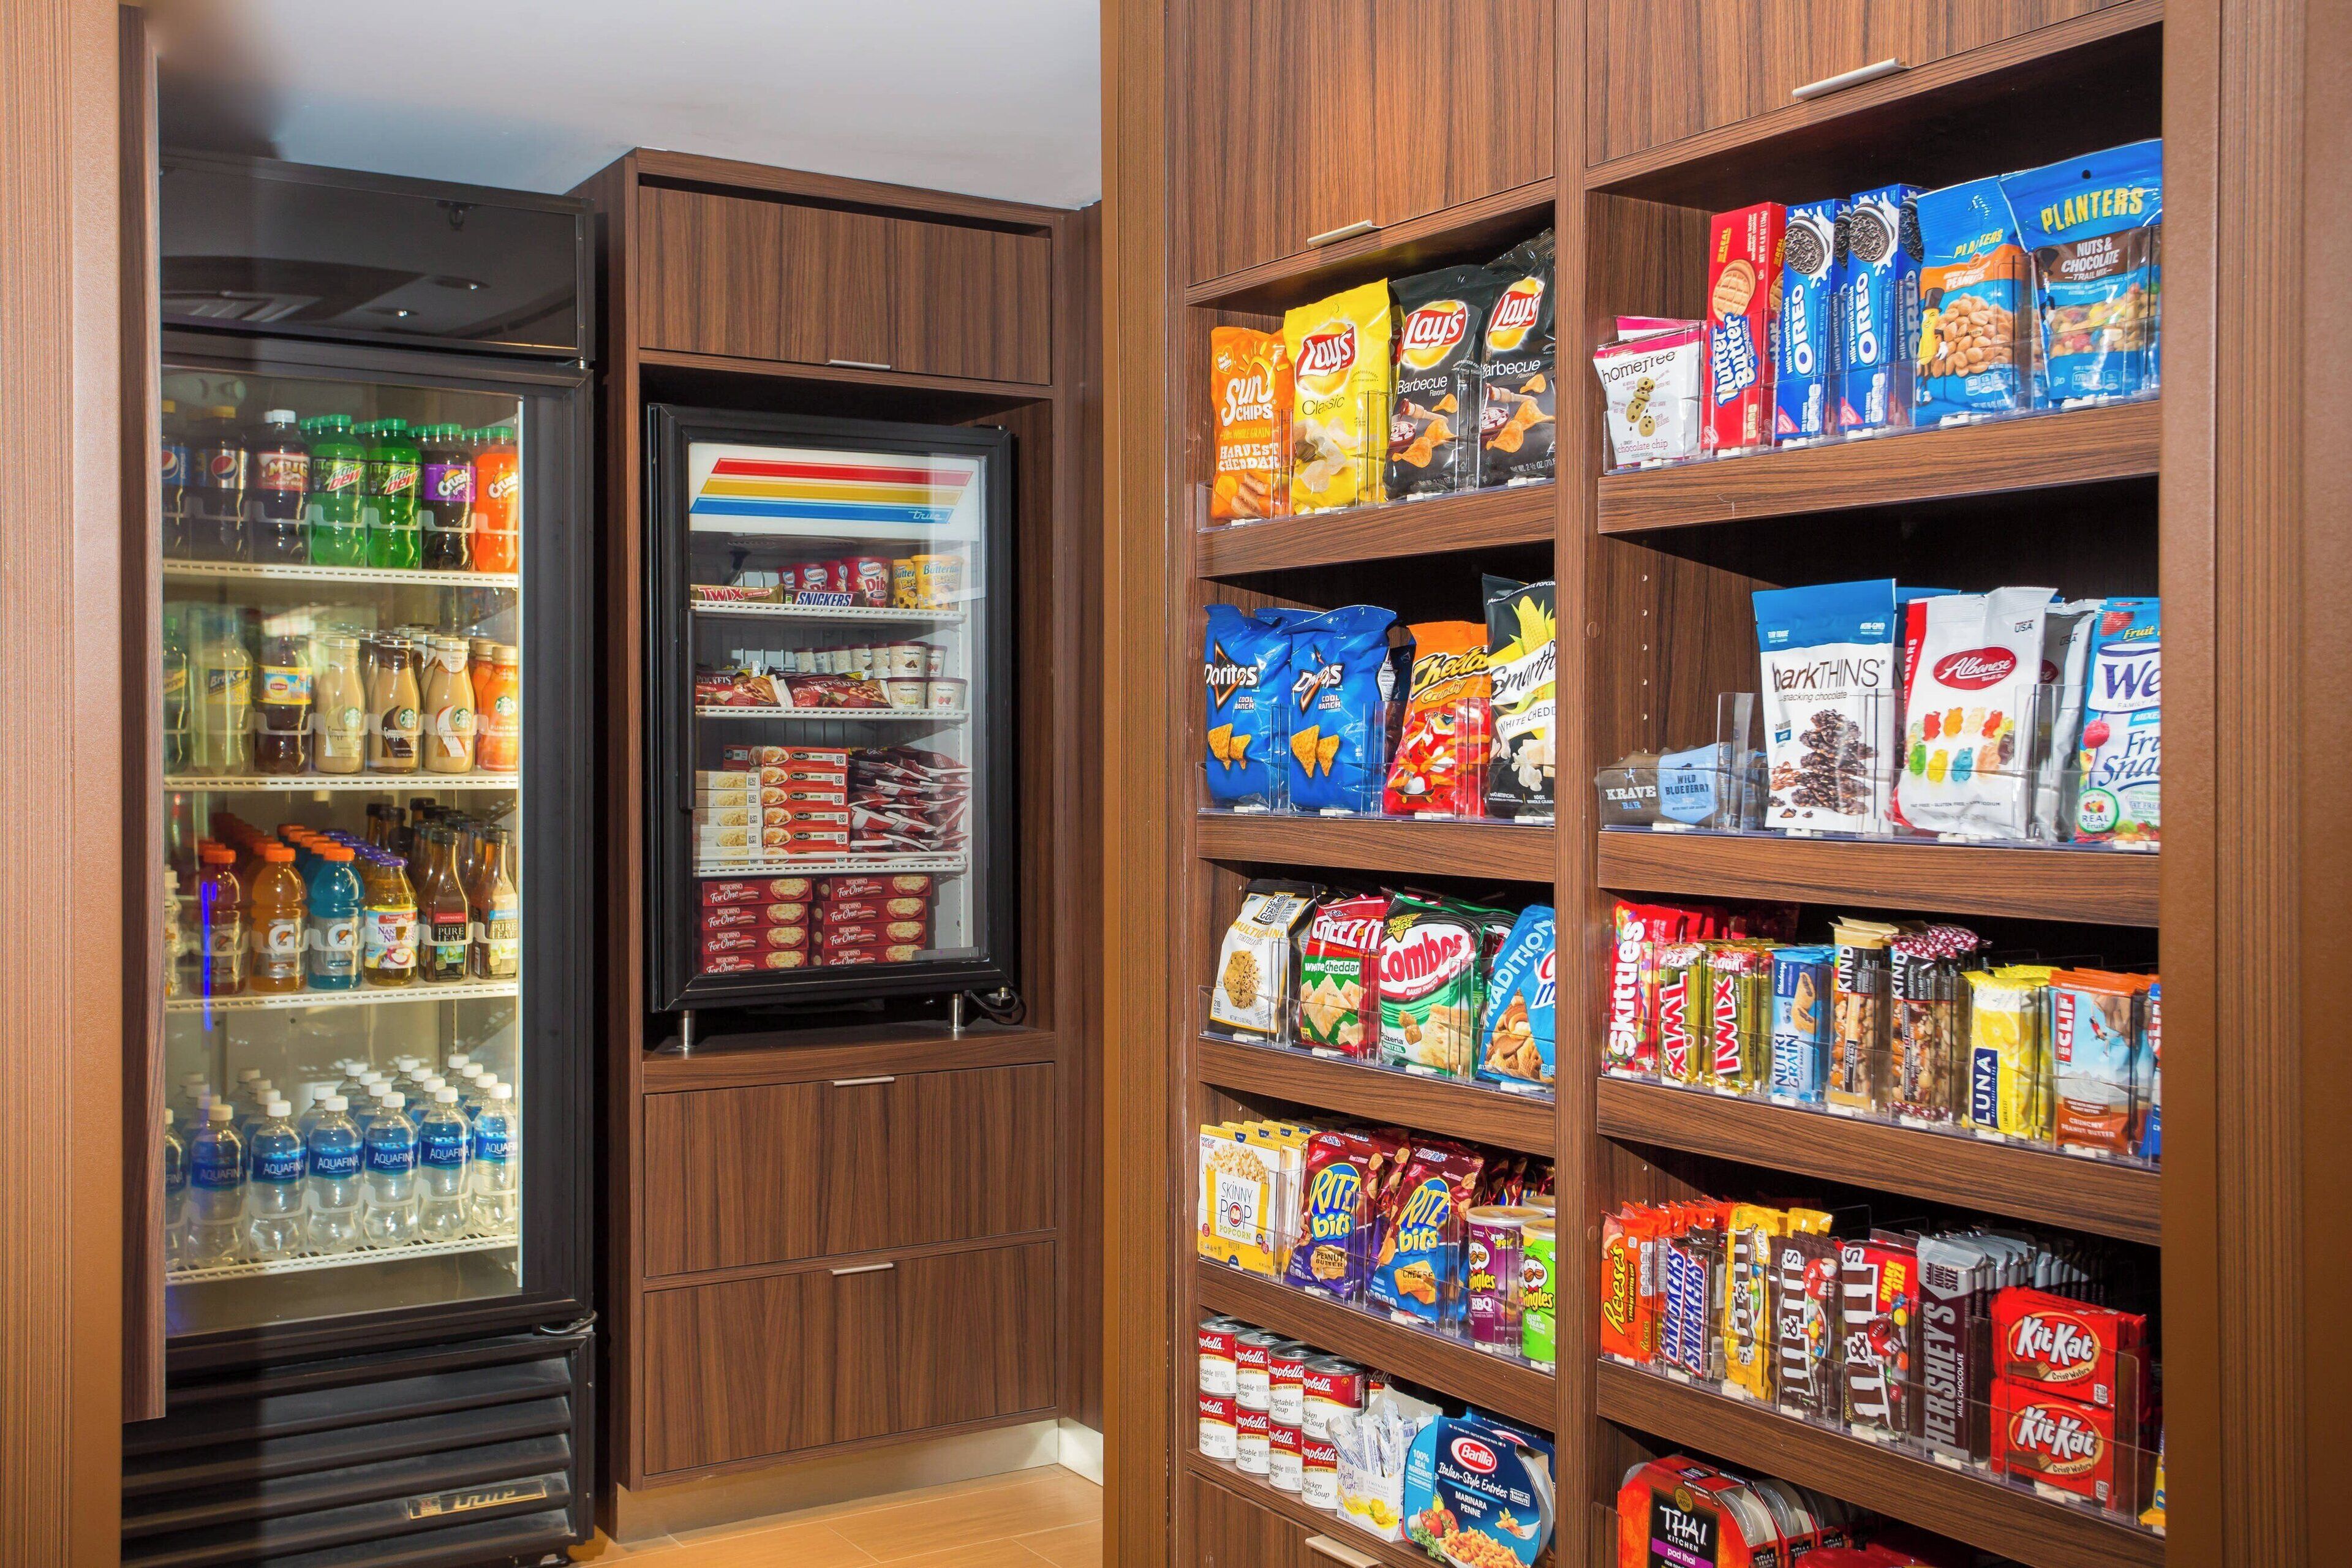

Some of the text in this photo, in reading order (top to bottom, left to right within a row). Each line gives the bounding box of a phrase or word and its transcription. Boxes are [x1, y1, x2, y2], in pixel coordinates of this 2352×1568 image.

[2041, 187, 2145, 234] PLANTERS
[2077, 238, 2103, 257] NUTS
[2060, 249, 2120, 273] CHOCOLATE
[2073, 269, 2107, 281] TRAIL MIX
[1490, 291, 1542, 332] Lay's
[1856, 271, 1878, 364] OREO
[1403, 311, 1464, 350] Lay's
[1792, 283, 1814, 375] OREO
[1725, 315, 1757, 389] Butter
[1482, 360, 1541, 379] Barbecue
[1601, 351, 1675, 385] homefree
[1785, 353, 1793, 375] Milk's
[1516, 371, 1536, 380] Flavored
[1397, 376, 1448, 394] Barbecue
[1429, 388, 1446, 397] Flavored
[1236, 404, 1273, 421] CHIPS
[1302, 394, 1345, 415] Classic
[1219, 442, 1279, 459] HARVEST
[1617, 438, 1668, 453] chocolate chip
[1218, 456, 1280, 472] CHEDDAR
[438, 470, 470, 497] Crush
[908, 511, 942, 520] true
[698, 587, 744, 601] TWIX
[797, 592, 851, 607] SNICKERS
[2015, 623, 2033, 633] USA
[2123, 627, 2155, 640] Fruit
[1204, 664, 1258, 686] Doritos
[1411, 646, 1488, 699] Cheetos
[1772, 658, 1879, 693] barkTHINS
[1939, 657, 2011, 679] Albanese
[1422, 680, 1467, 703] Crunchy
[1782, 690, 1847, 703] snacking chocolate
[1318, 701, 1341, 710] RANCH
[1499, 717, 1526, 734] WHITE
[1677, 774, 1696, 784] WILD
[1605, 785, 1657, 800] KRAVE
[1665, 783, 1709, 795] BLUEBERRY
[1622, 801, 1642, 810] BAR
[710, 890, 739, 903] For One
[837, 884, 864, 898] For One
[438, 926, 464, 935] PURE
[492, 922, 517, 932] PURE
[1387, 922, 1413, 935] CHEESE
[1391, 917, 1412, 929] REAL
[1379, 932, 1463, 983] Combos
[1325, 960, 1359, 973] cheddar
[1837, 945, 1853, 993] KIND
[1891, 952, 1909, 1000] KIND
[1406, 987, 1422, 996] BAKED
[1611, 918, 1646, 1058] Skittles
[1659, 971, 1689, 1076] TWIX
[1715, 974, 1742, 1074] TWIX
[2058, 998, 2075, 1044] CLIF
[1775, 1033, 1787, 1087] NUTRI
[1786, 1034, 1800, 1089] GRAIN
[1975, 1054, 1992, 1126] LUNA
[2060, 1123, 2116, 1138] PEANUT BUTTER
[2068, 1117, 2105, 1129] CRUNCHY
[374, 1150, 415, 1166] AQUAFINA
[429, 1144, 470, 1160] AQUAFINA
[263, 1159, 304, 1175] AQUAFINA
[317, 1155, 360, 1170] AQUAFINA
[200, 1166, 244, 1181] AQUAFINA
[1309, 1169, 1362, 1215] RITZ
[1219, 1199, 1252, 1230] POP
[1396, 1185, 1451, 1229] RITZ
[1219, 1224, 1251, 1240] POPCORN
[1312, 1213, 1351, 1238] bits
[1399, 1228, 1437, 1253] bits
[1316, 1251, 1344, 1261] PEANUT
[1316, 1259, 1344, 1267] BUTTER
[1880, 1259, 1896, 1303] SHARE
[1893, 1262, 1907, 1292] SIZE
[1934, 1264, 1945, 1288] KING
[1945, 1268, 1958, 1291] SIZE
[1603, 1243, 1626, 1336] Reese's
[1471, 1297, 1493, 1312] BBQ
[1640, 1320, 1649, 1352] Reese's
[1924, 1302, 1956, 1450] HERSHEY'S
[2052, 1366, 2090, 1381] Crisp Wafers
[1238, 1388, 1250, 1397] Soup
[1270, 1395, 1294, 1407] Vegetable
[1275, 1404, 1288, 1415] Soup
[1310, 1419, 1324, 1430] Soup
[1240, 1453, 1251, 1463] Soup
[1412, 1449, 1430, 1463] 100%
[1414, 1459, 1426, 1469] REAL
[1460, 1447, 1492, 1468] Barilla
[1408, 1466, 1433, 1480] INGREDIENTS
[2052, 1461, 2092, 1473] Crisp Wafers
[1303, 1477, 1322, 1489] Chicken
[1338, 1469, 1354, 1484] Crystal
[1438, 1462, 1508, 1499] Italian-Style Entrées
[1314, 1487, 1330, 1499] Soup
[1455, 1491, 1487, 1510] MARINARA
[1513, 1495, 1529, 1505] MINUTE
[1460, 1504, 1481, 1518] PENNE
[1659, 1504, 1706, 1546] THAI
[1667, 1534, 1699, 1553] KITCHEN
[1667, 1548, 1696, 1566] pad thai
